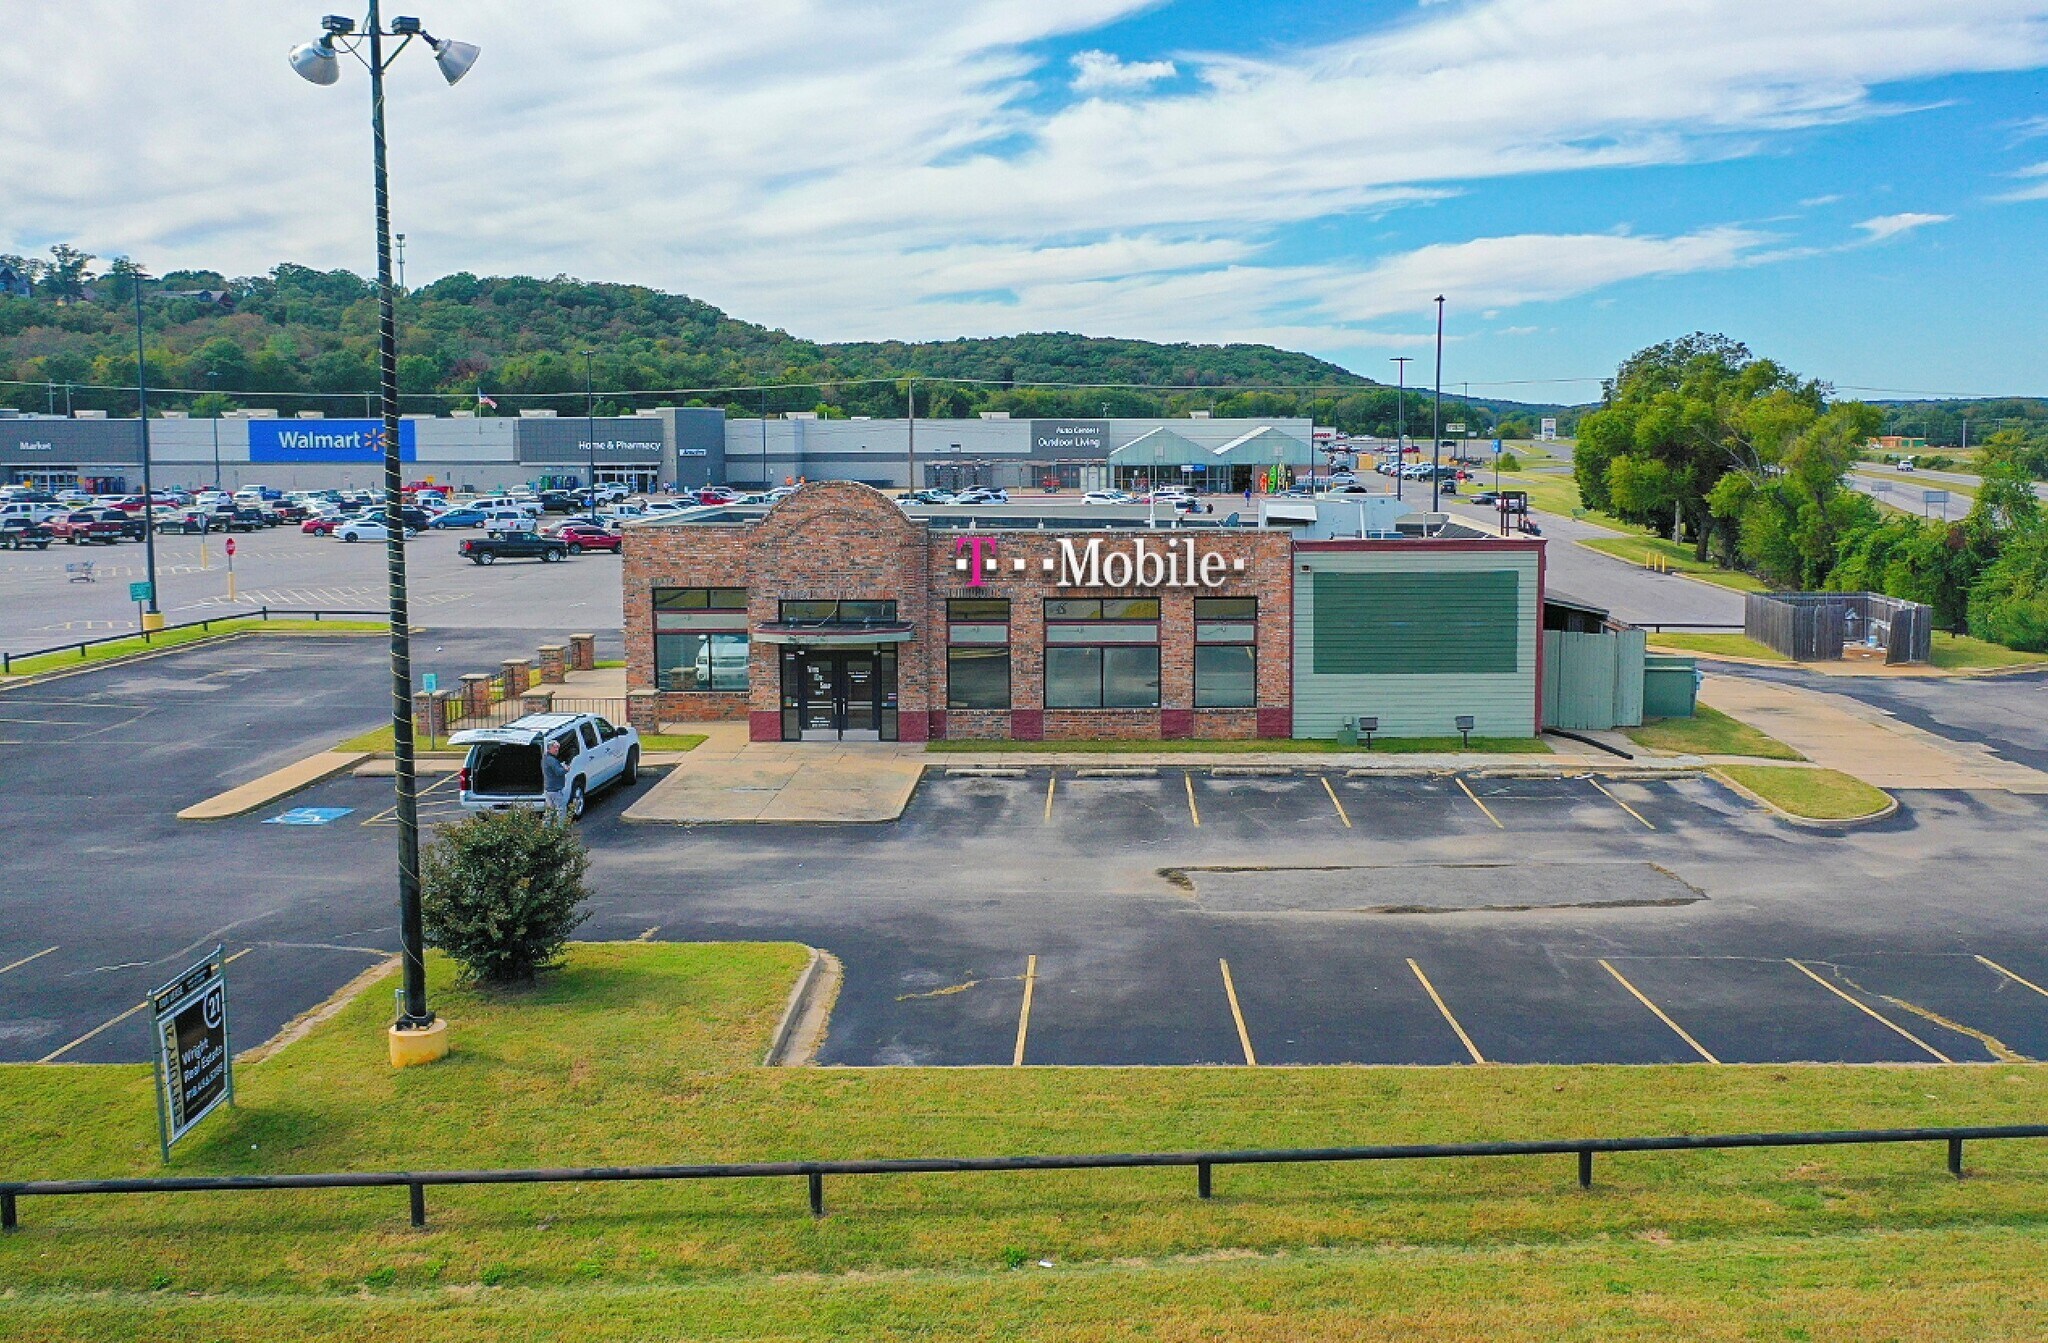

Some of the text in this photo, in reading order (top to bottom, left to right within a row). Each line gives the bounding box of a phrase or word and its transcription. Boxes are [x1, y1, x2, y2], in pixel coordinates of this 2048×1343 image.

[1056, 426, 1073, 434] Auto
[20, 440, 52, 450] Market
[278, 430, 361, 449] Walmart
[579, 440, 661, 452] Home & Pharmacy
[1038, 437, 1100, 449] Outdoor Living
[208, 991, 221, 1019] 21
[182, 1037, 209, 1066] Wright
[184, 1045, 223, 1084] Real Estate
